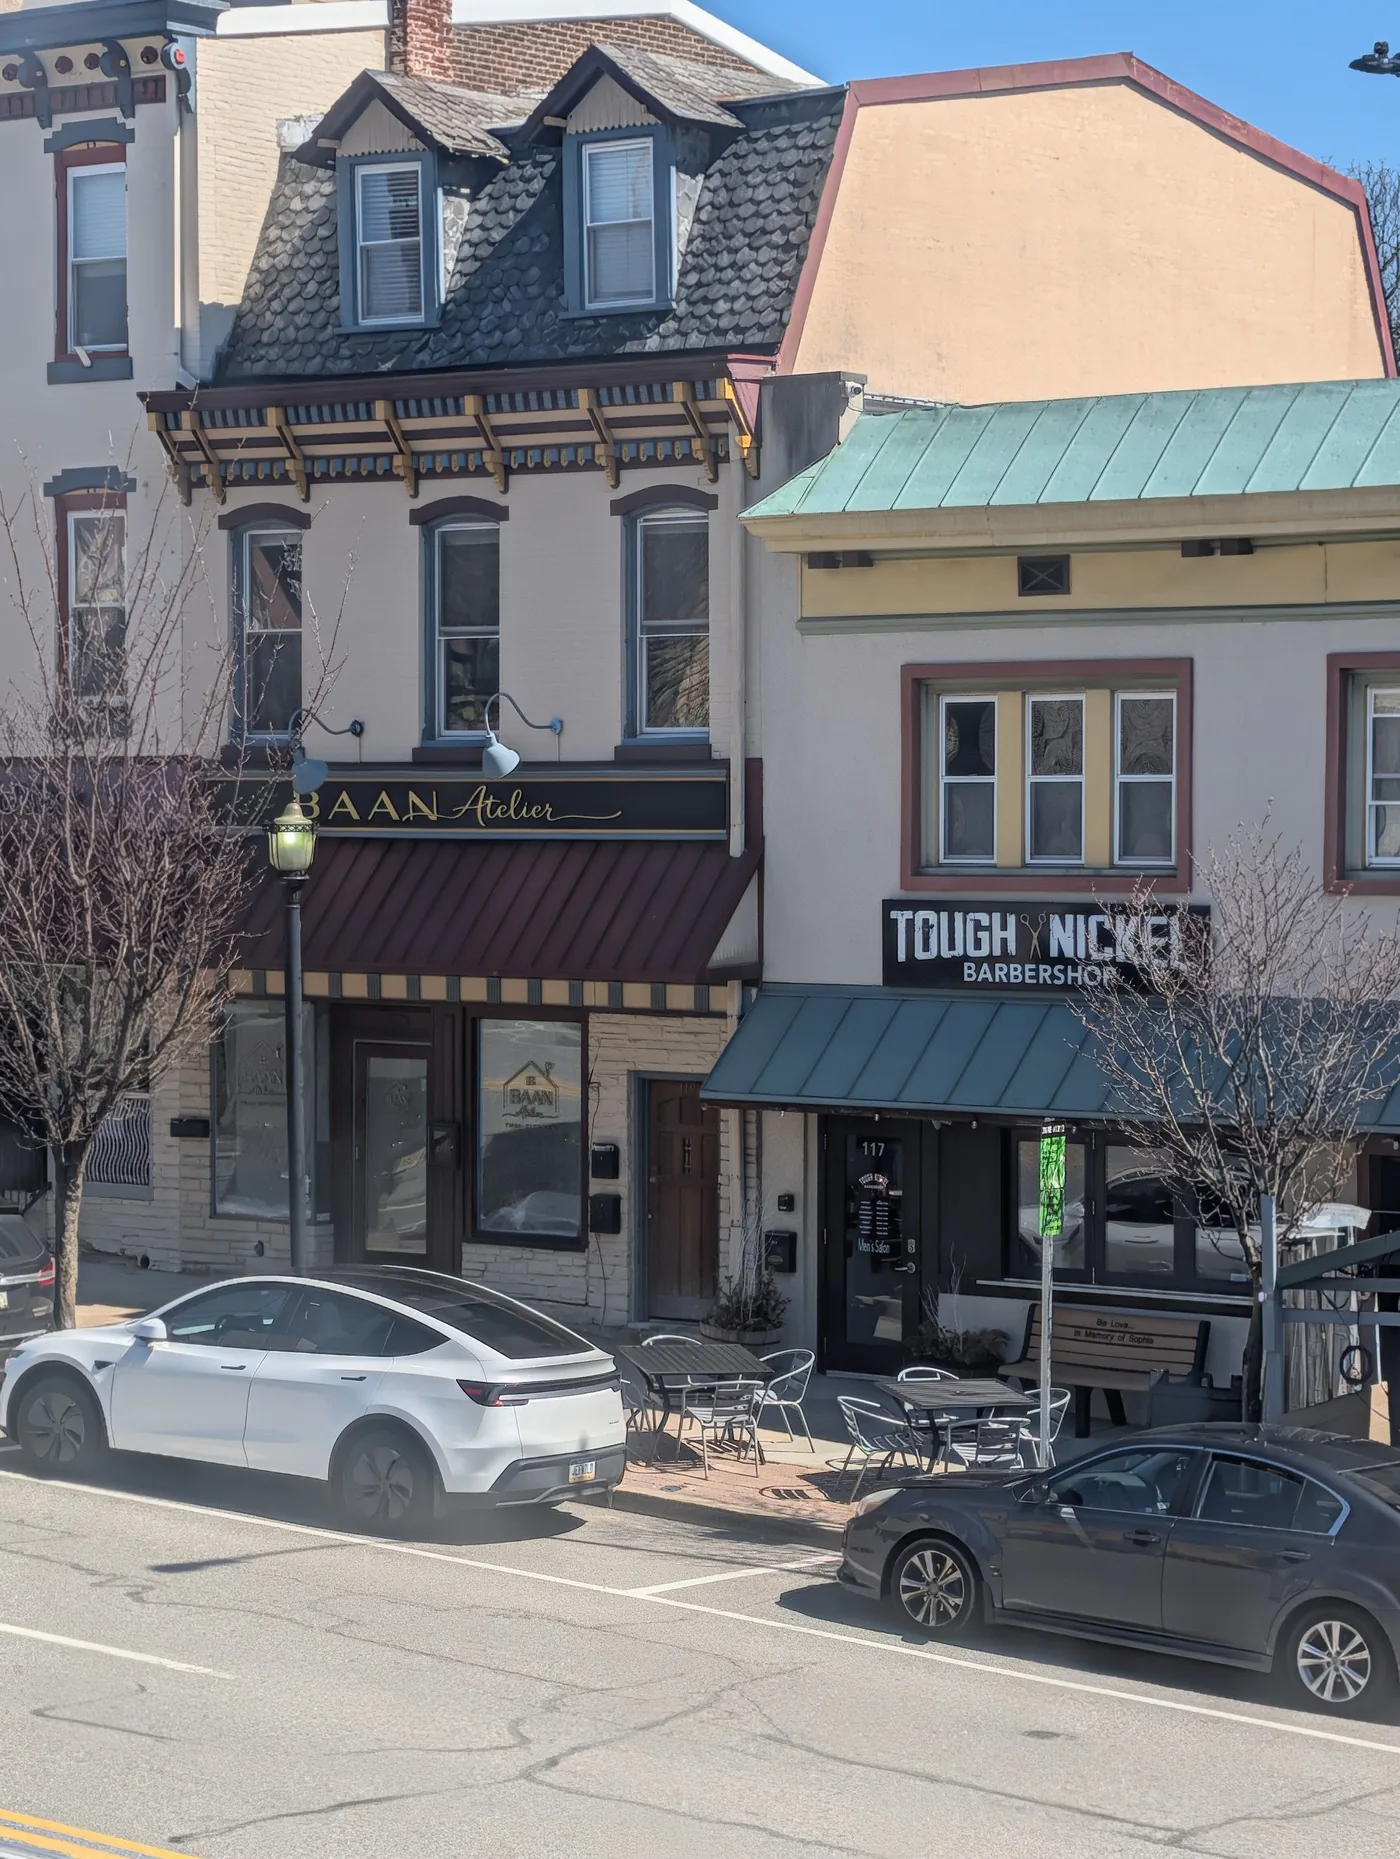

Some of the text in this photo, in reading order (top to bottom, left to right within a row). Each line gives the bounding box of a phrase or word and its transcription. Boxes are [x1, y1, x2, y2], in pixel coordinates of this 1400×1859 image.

[296, 785, 622, 827] BAAN Atelier
[890, 910, 1016, 963] TOUGH
[509, 1089, 554, 1106] BAAN
[862, 1141, 885, 1157] 117
[1096, 1318, 1108, 1327] Be
[1085, 1330, 1115, 1342] Memory
[1118, 1333, 1126, 1342] of
